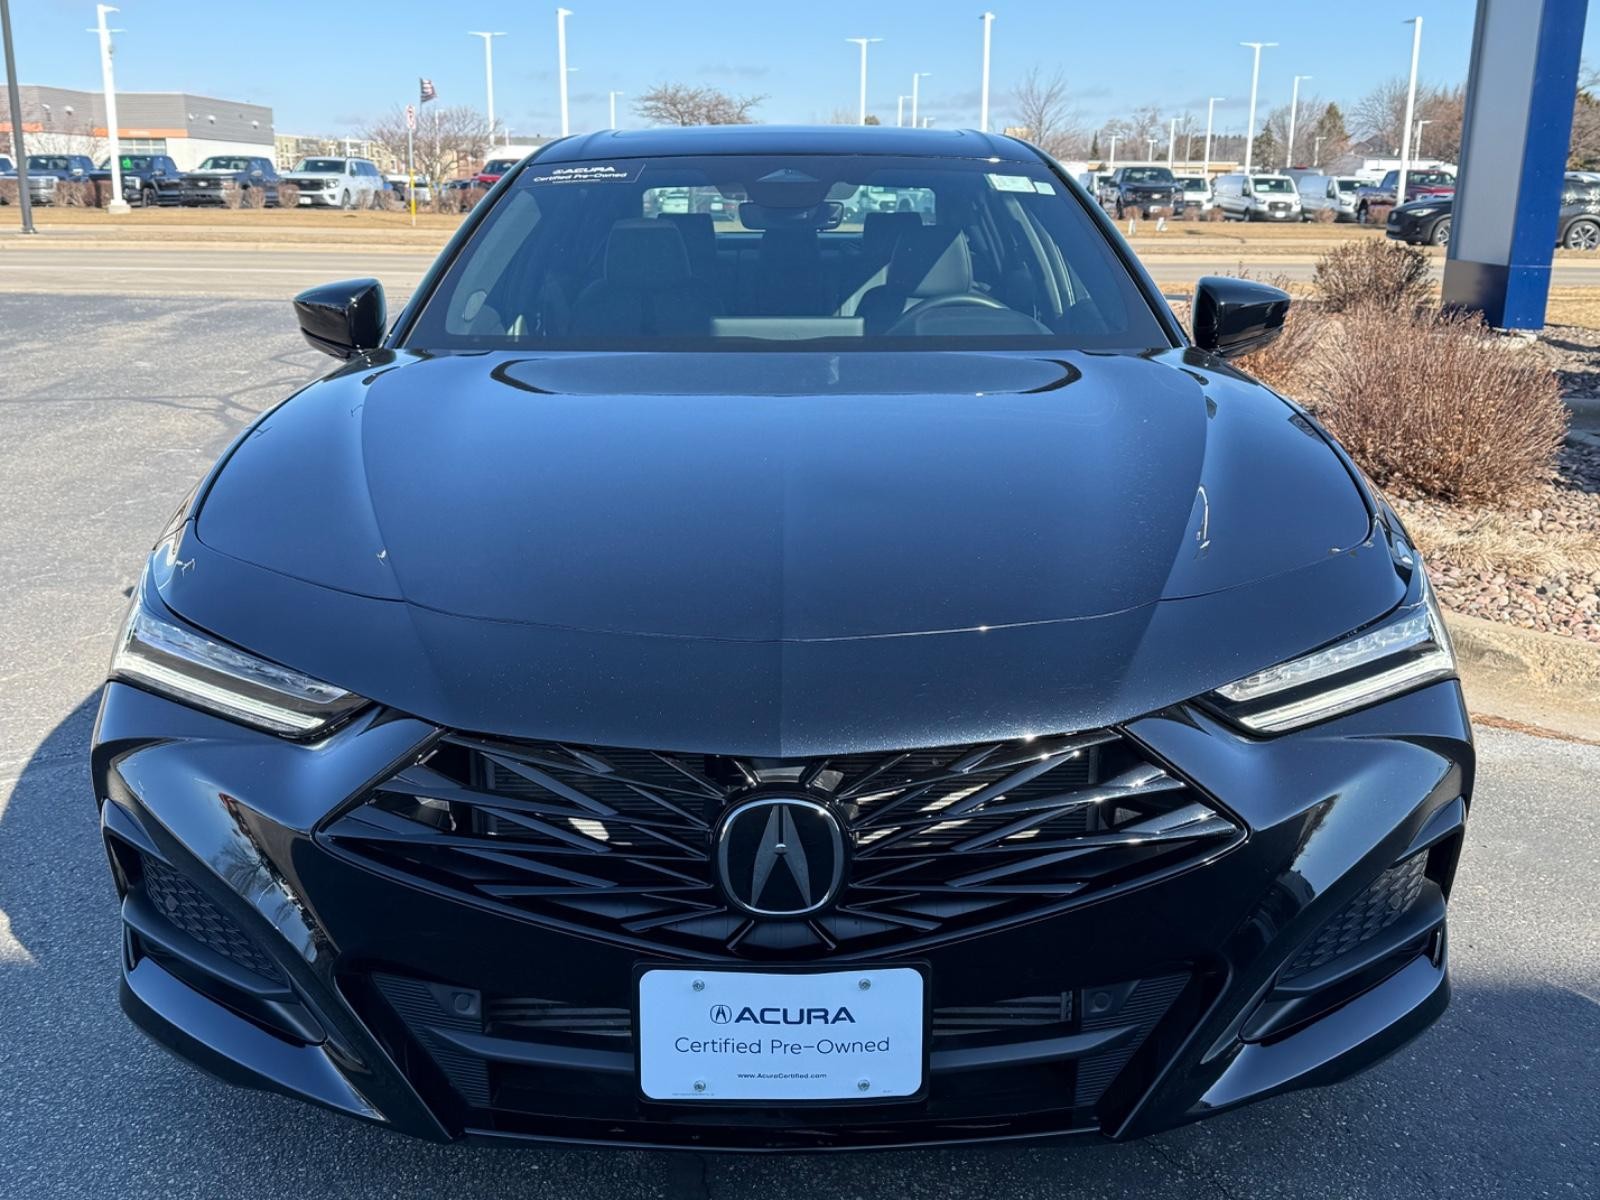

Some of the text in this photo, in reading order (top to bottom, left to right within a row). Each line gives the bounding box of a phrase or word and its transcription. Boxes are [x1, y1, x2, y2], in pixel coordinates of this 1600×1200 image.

[562, 166, 615, 174] ACURA
[534, 174, 573, 182] Certified
[734, 1006, 856, 1025] ACURA
[674, 1036, 890, 1055] Certified Pre-Owned
[737, 1072, 827, 1080] www.AcuraCertified.com
